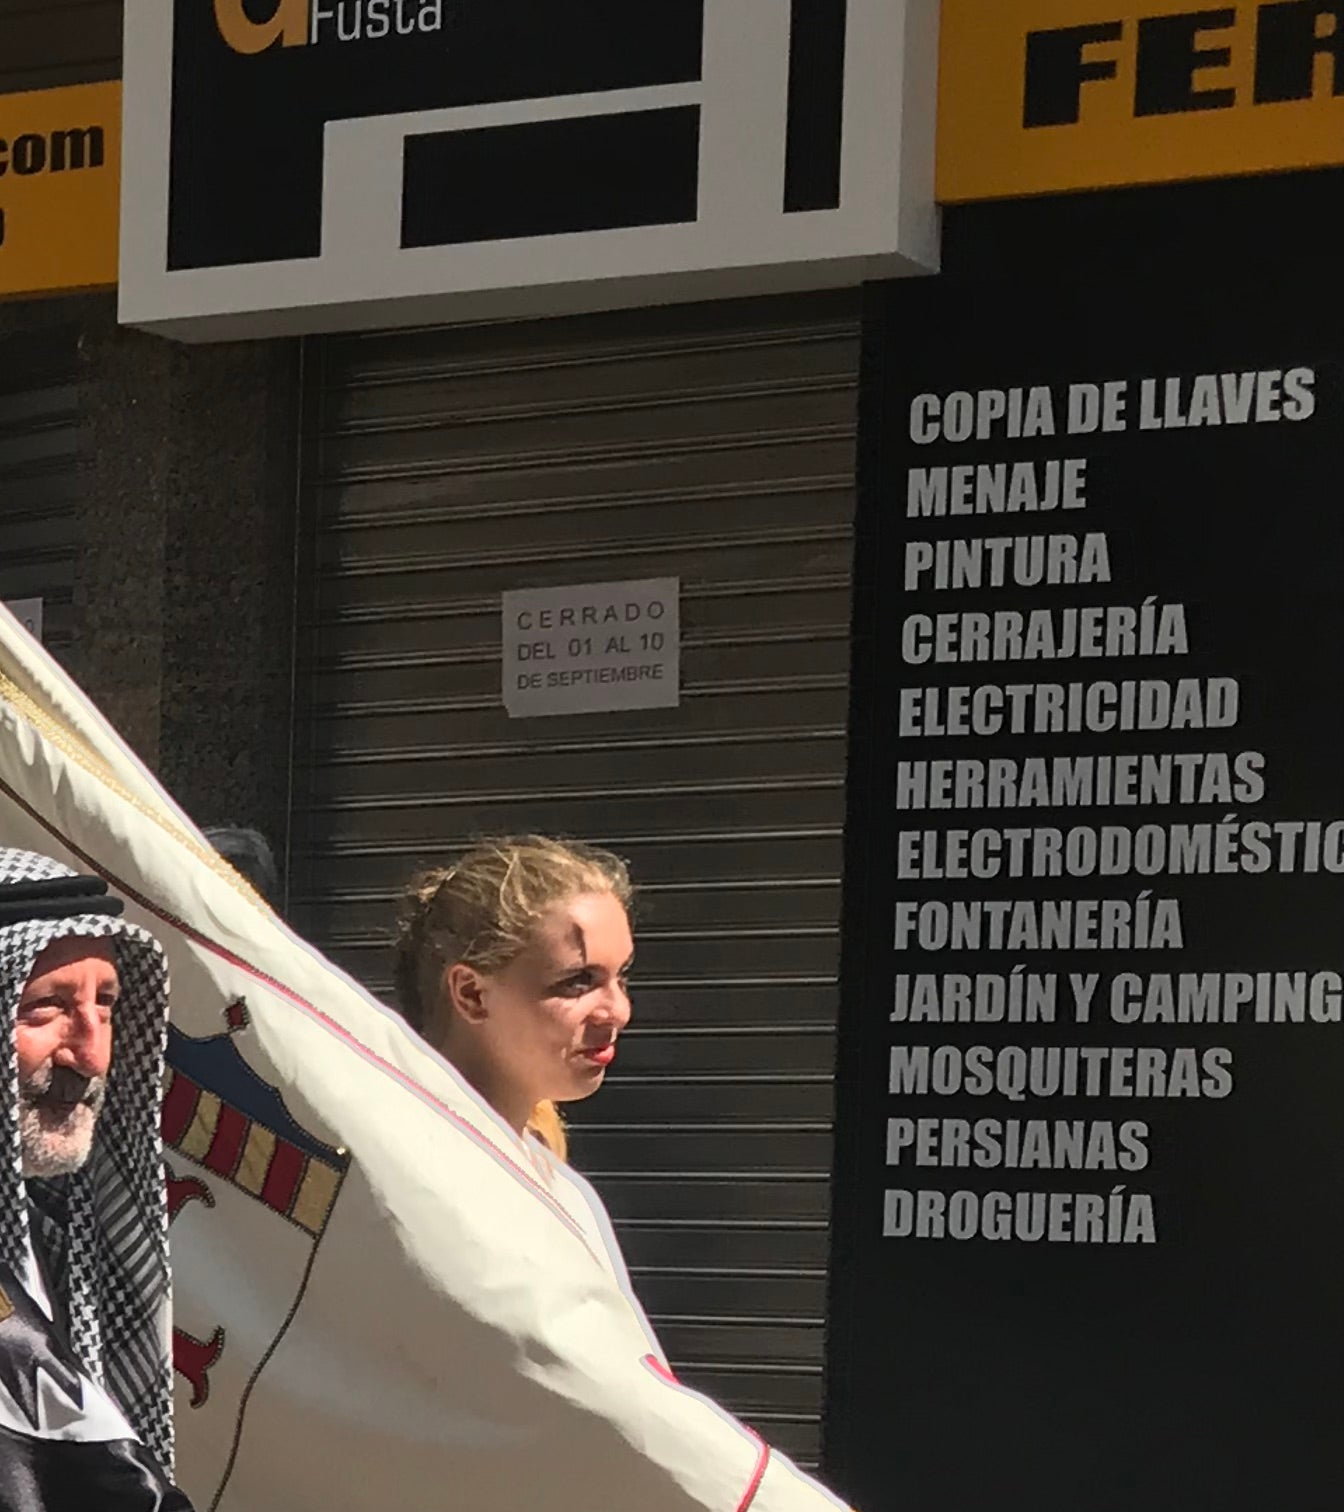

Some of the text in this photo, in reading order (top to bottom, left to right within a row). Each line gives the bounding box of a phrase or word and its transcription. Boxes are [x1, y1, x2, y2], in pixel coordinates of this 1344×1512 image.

[1023, 0, 1344, 128] FER
[910, 367, 1316, 444] COPIA DE LLAVES
[906, 458, 1087, 518] MENAJE
[904, 532, 1111, 591] PINTURA
[517, 601, 665, 631] CERRADO
[901, 596, 1189, 664] CERRAJERÍA
[517, 632, 664, 661] DEL 01 AL 10
[517, 663, 664, 689] DE SEPTIEMBRE
[898, 677, 1240, 737] ELECTRICIDAD
[896, 751, 1266, 810] HERRAMIENTAS
[894, 890, 1184, 950] FONTANERÍA
[889, 964, 1344, 1024] JARDÍN Y CAMPING
[888, 1045, 1233, 1101] MOSQUITERAS
[885, 1117, 1149, 1171] PERSIANAS
[882, 1185, 1157, 1243] DROGUERÍA
